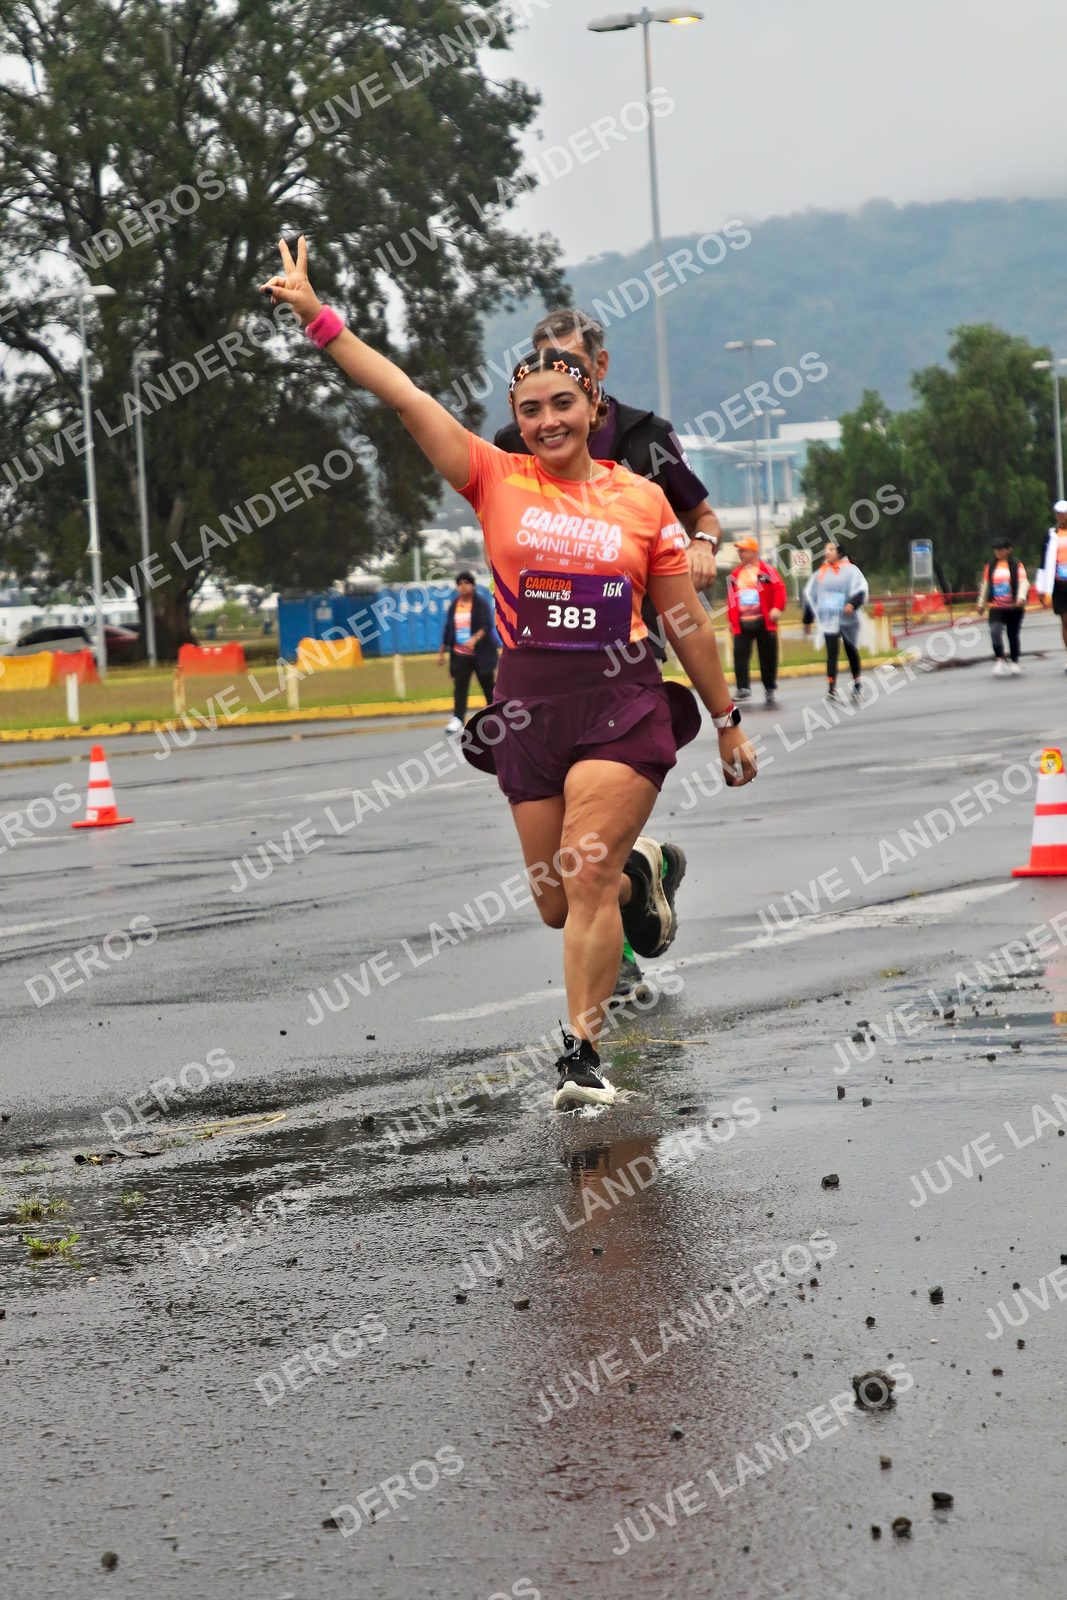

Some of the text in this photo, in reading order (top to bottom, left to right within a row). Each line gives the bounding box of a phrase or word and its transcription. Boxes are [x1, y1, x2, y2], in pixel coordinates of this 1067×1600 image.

[521, 506, 622, 548] CARRERA
[516, 529, 596, 559] OMNILIFE
[524, 589, 561, 601] OMNILIFE
[525, 576, 572, 591] CARRERA
[546, 604, 596, 629] 383
